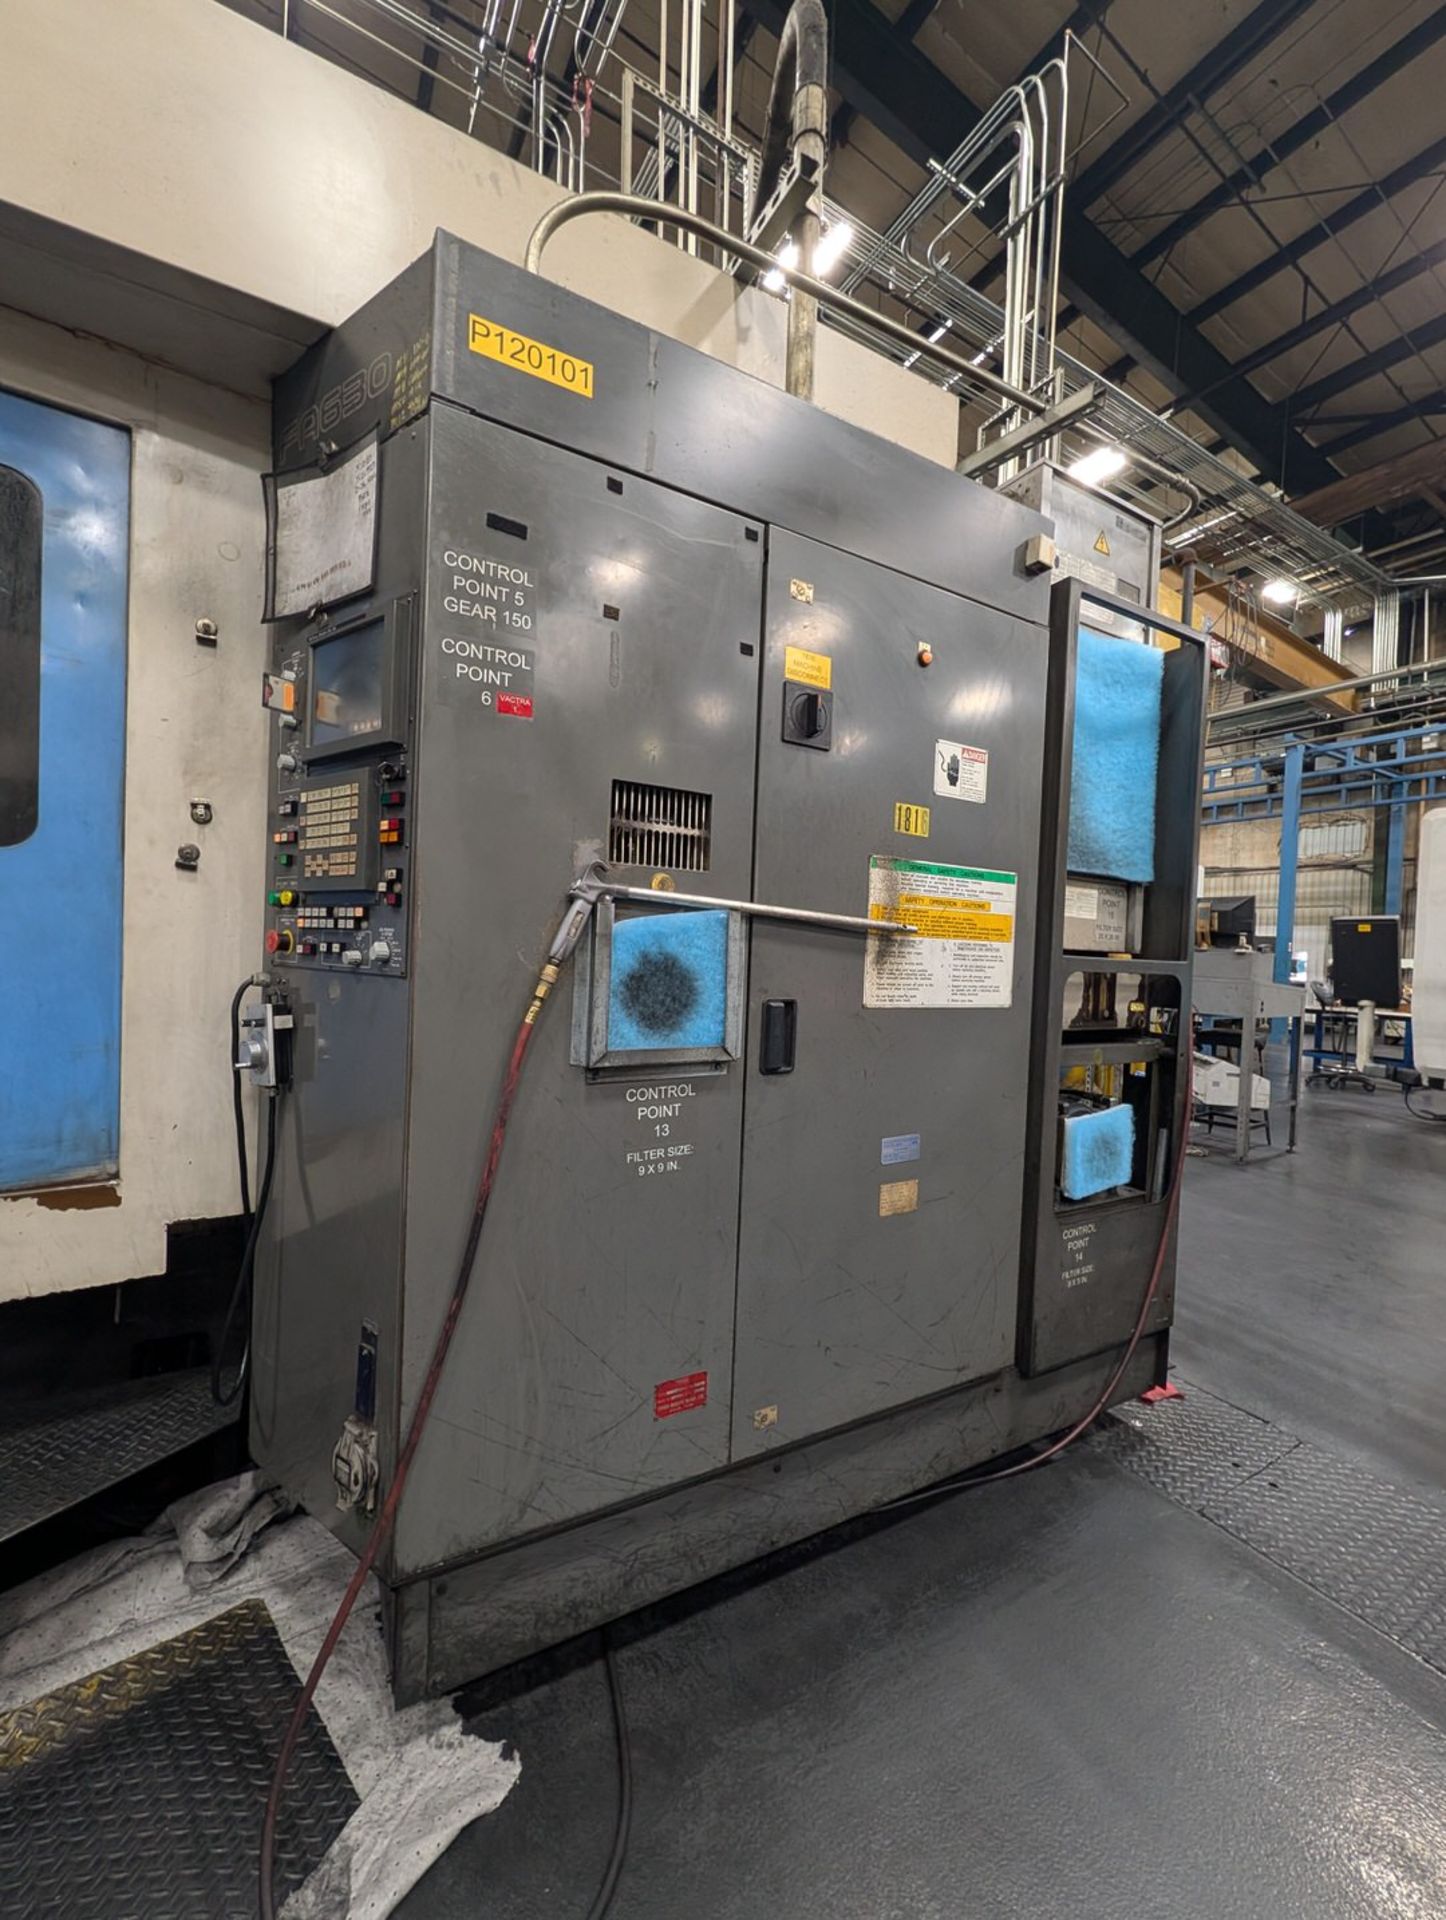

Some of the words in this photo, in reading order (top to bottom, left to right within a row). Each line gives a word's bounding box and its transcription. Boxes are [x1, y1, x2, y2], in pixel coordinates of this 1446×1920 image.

[472, 319, 589, 389] P120101
[444, 551, 533, 587] CONTROL
[453, 575, 509, 602] POINT
[514, 591, 524, 606] 5
[444, 596, 497, 622] GEAR
[503, 611, 531, 630] 150
[442, 638, 531, 670] CONTROL
[456, 663, 512, 687] POINT
[481, 691, 491, 705] 6
[897, 805, 928, 835] 1816
[626, 1083, 696, 1102] CONTROL
[638, 1103, 681, 1120] POINT
[654, 1123, 670, 1137] 13
[626, 1148, 665, 1164] FILTER
[638, 1165, 645, 1176] 9
[647, 1164, 655, 1174] X
[657, 1163, 664, 1173] 9
[1062, 1224, 1096, 1240] CONTROL
[1067, 1237, 1089, 1252] POINT
